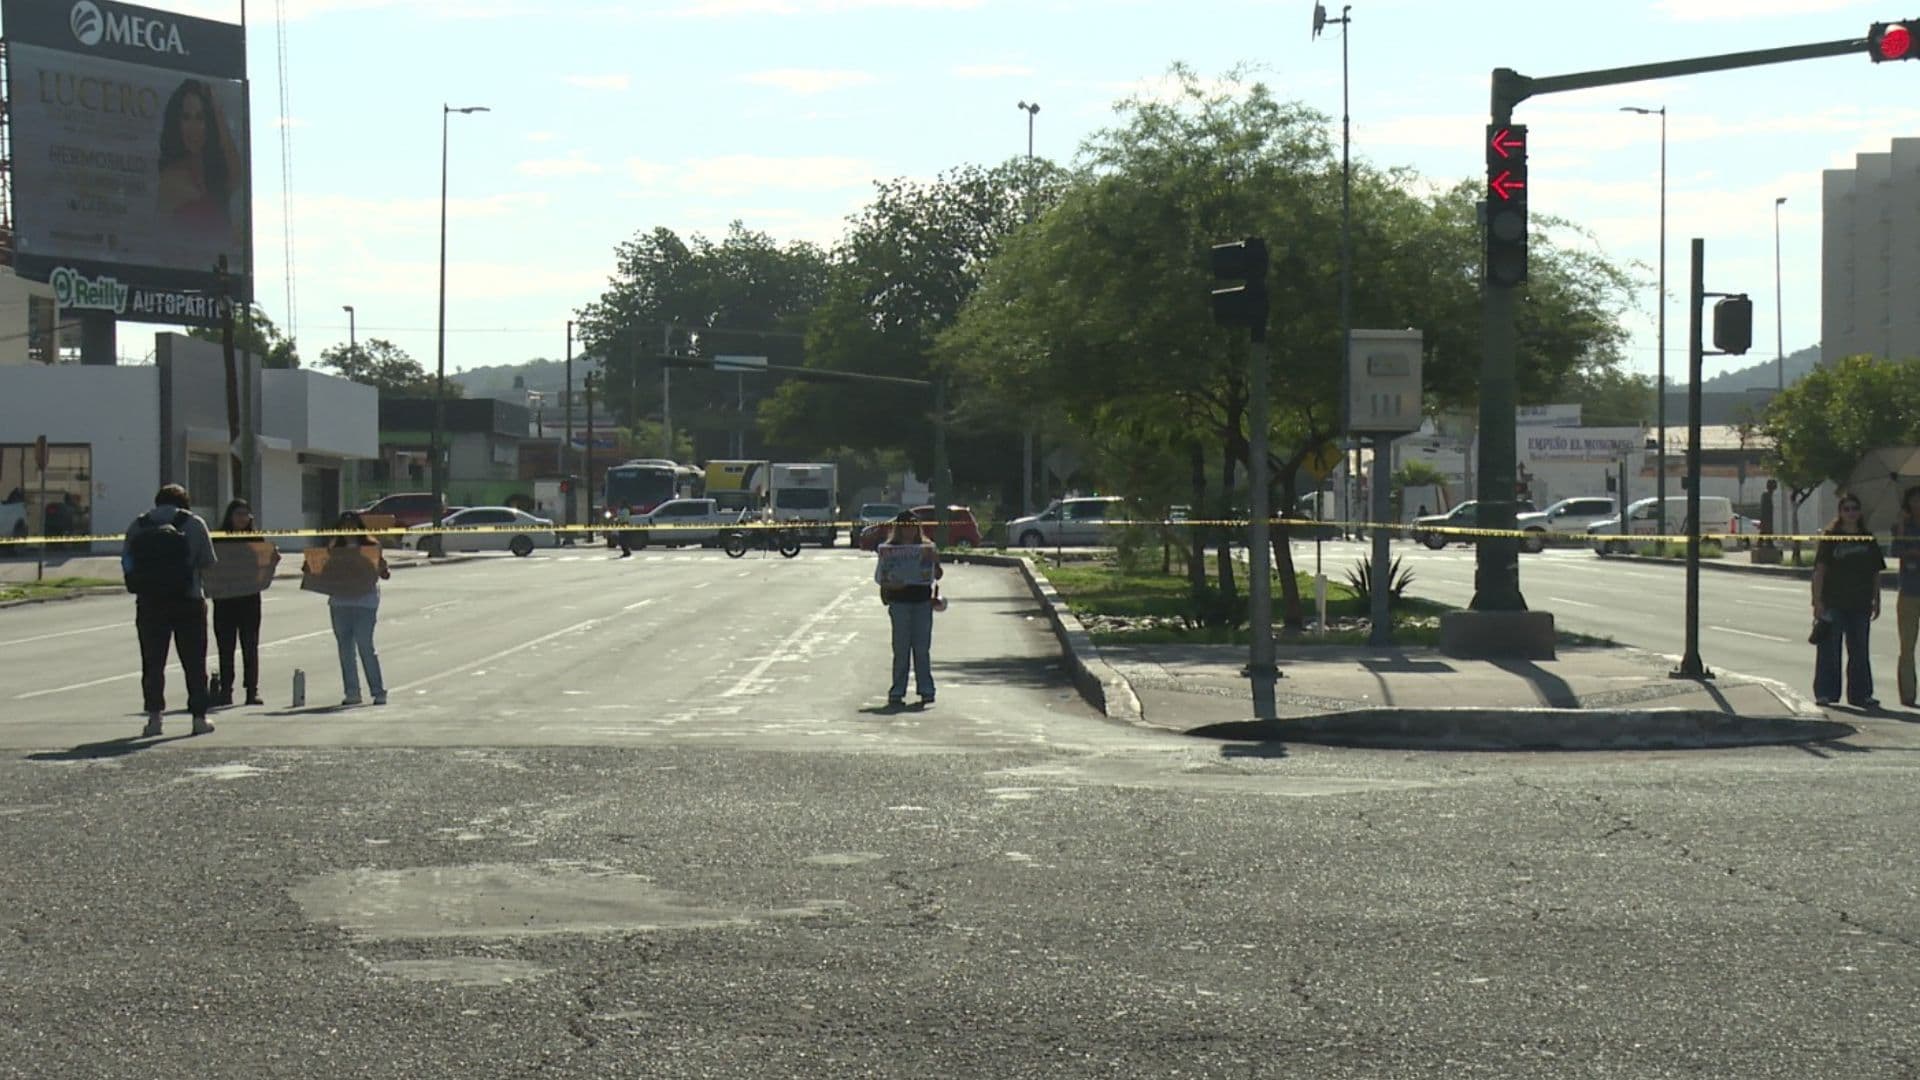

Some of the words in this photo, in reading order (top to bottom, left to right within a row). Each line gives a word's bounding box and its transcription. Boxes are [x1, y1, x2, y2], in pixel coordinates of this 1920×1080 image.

[105, 11, 184, 55] MEGA
[37, 70, 161, 119] LUCERO
[52, 268, 127, 313] O'Reilly
